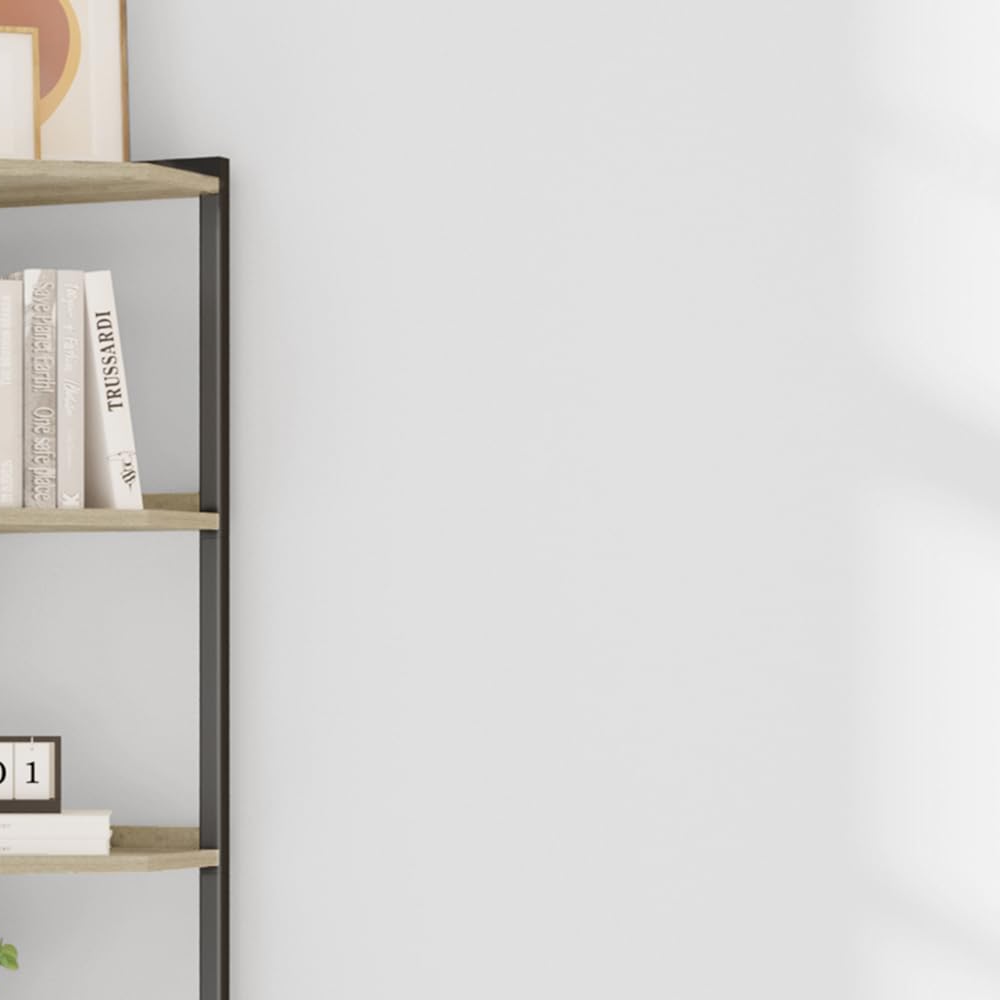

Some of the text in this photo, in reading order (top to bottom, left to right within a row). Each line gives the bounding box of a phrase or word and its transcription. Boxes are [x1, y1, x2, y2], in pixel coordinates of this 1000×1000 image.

[95, 311, 123, 412] TRUSSARDI
[29, 406, 56, 501] One safe place
